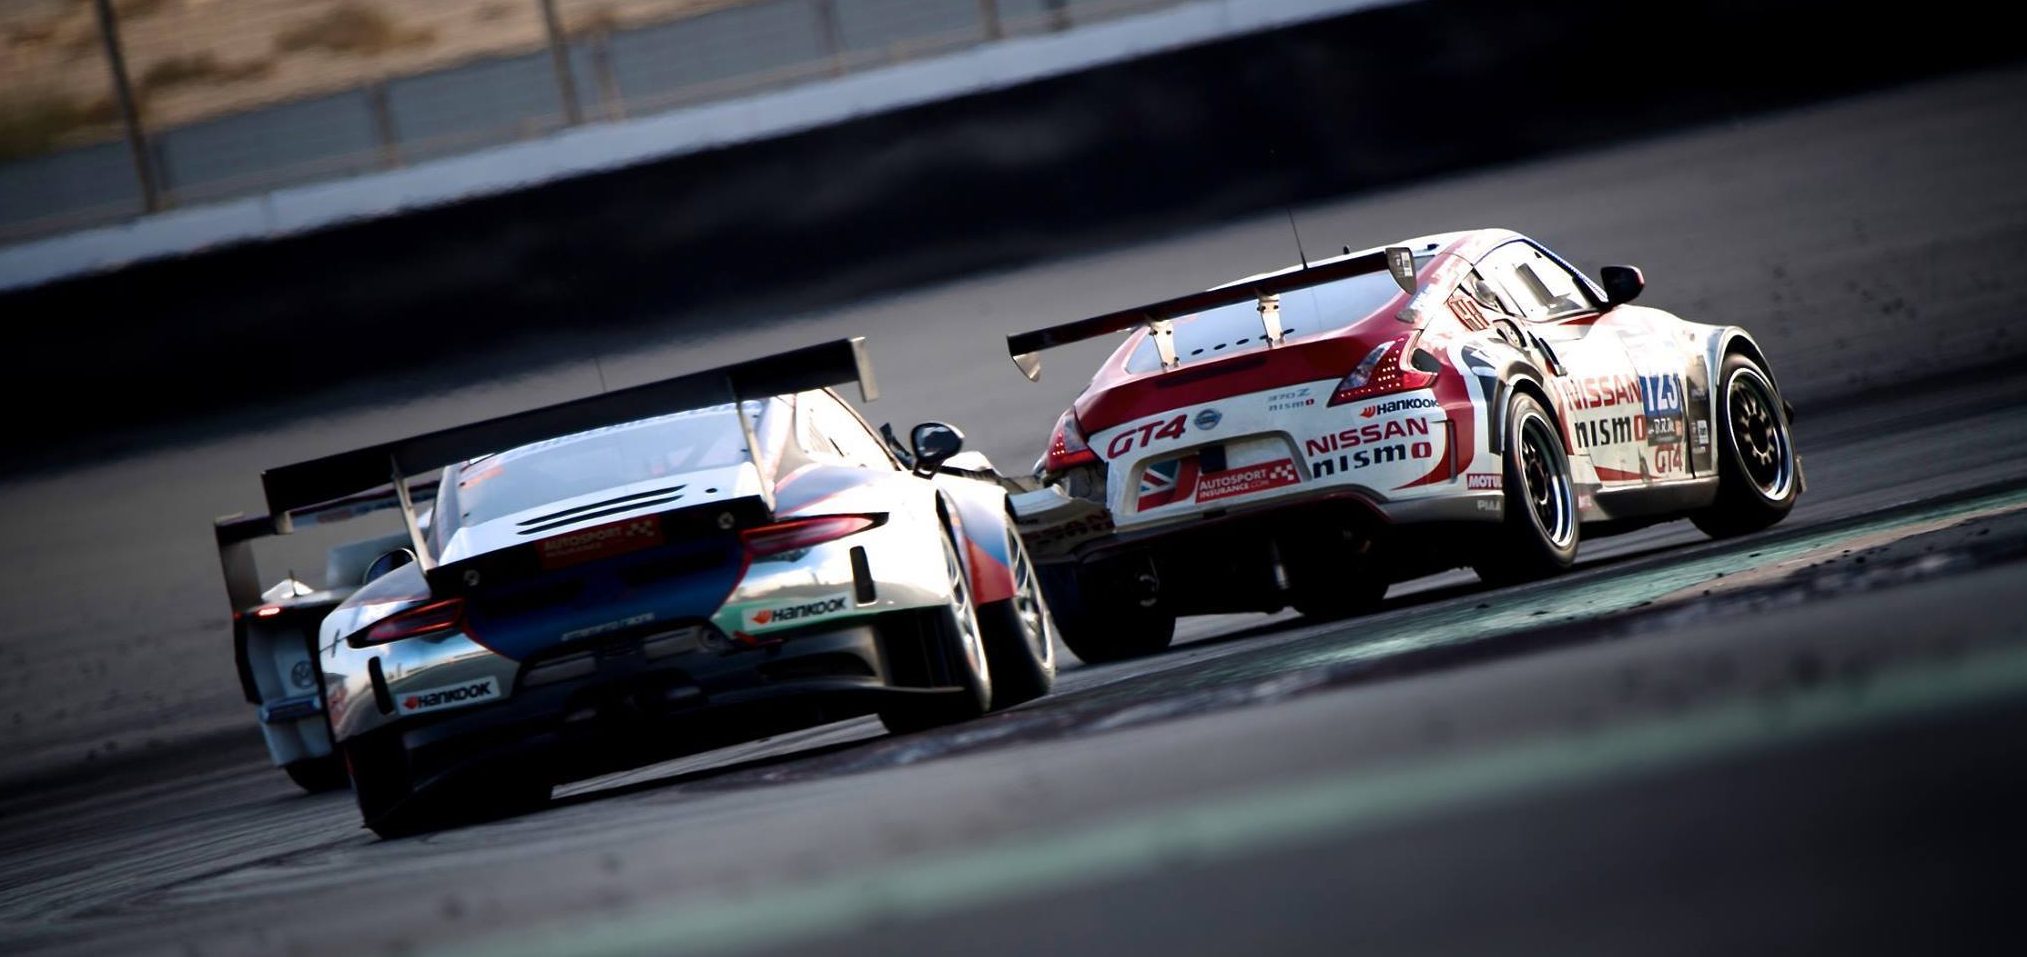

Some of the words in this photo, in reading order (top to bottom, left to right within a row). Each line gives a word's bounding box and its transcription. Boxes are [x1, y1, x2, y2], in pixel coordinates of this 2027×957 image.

[1107, 414, 1188, 459] GT4
[1305, 417, 1429, 457] NISSAN
[1199, 469, 1267, 491] AUTOSPORT
